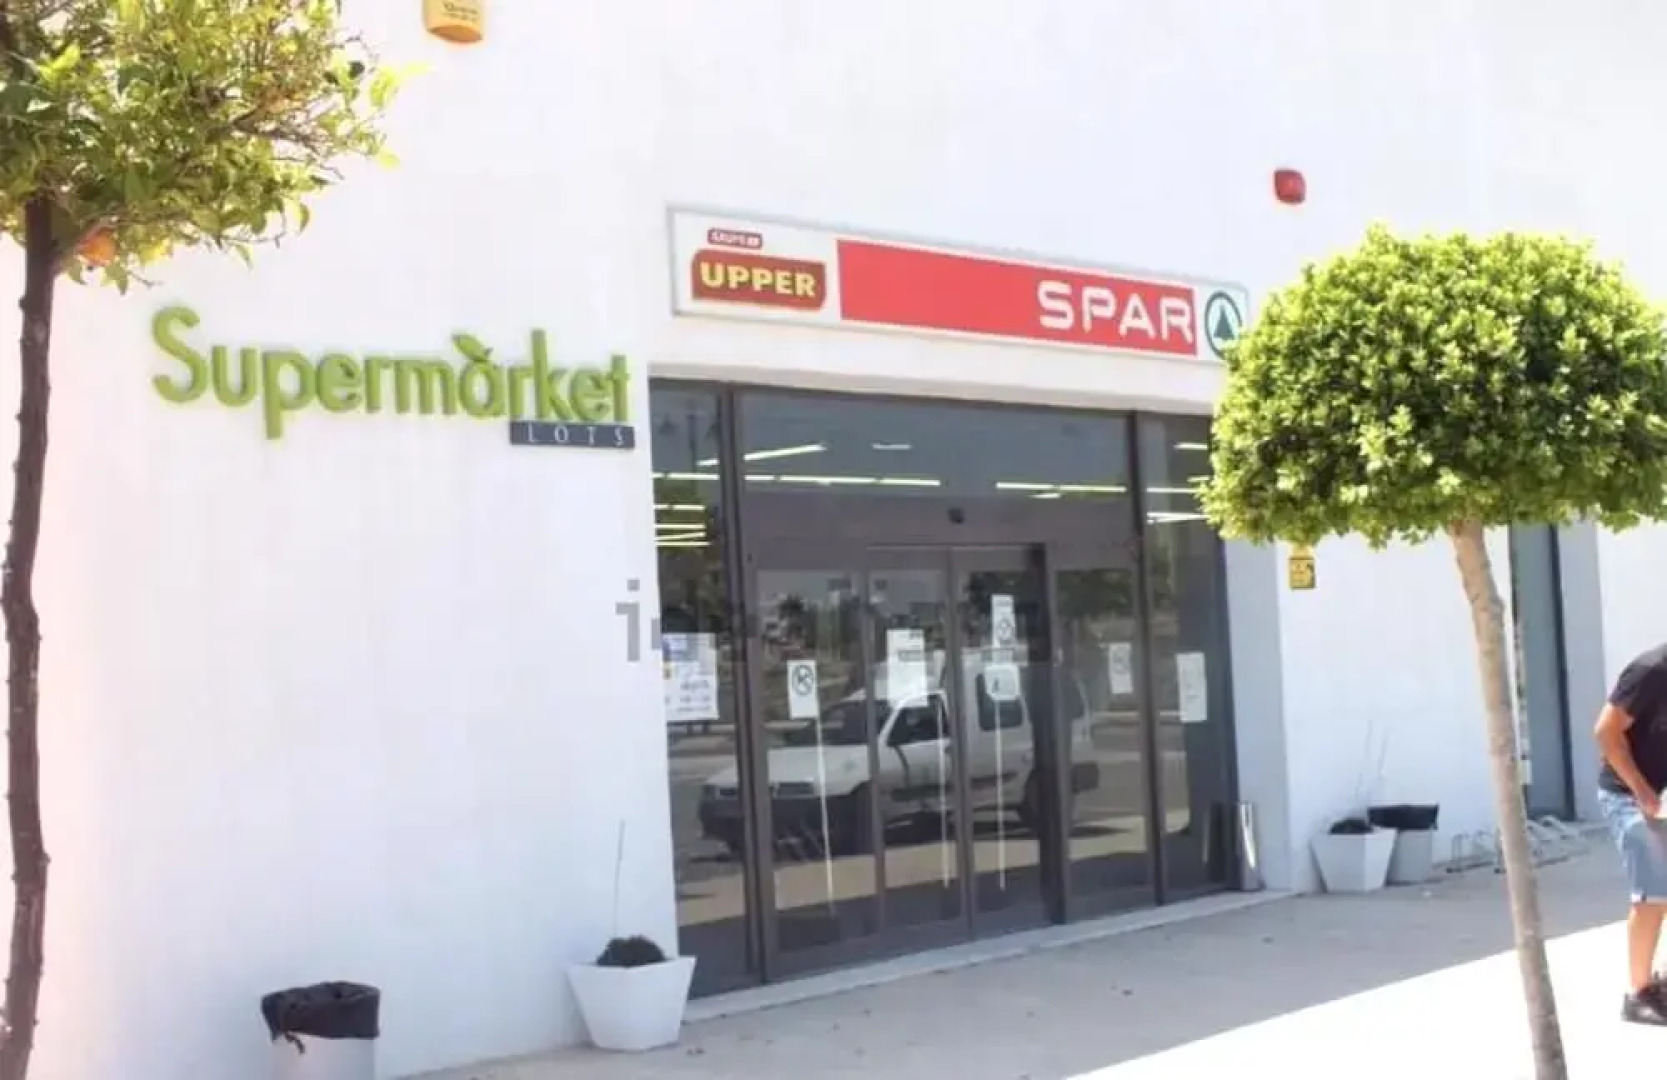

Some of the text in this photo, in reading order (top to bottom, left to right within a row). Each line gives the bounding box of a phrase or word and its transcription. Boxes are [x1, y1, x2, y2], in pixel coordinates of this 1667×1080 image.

[700, 261, 816, 297] UPPER
[1038, 281, 1193, 343] SPAR
[151, 305, 631, 440] Supermarket
